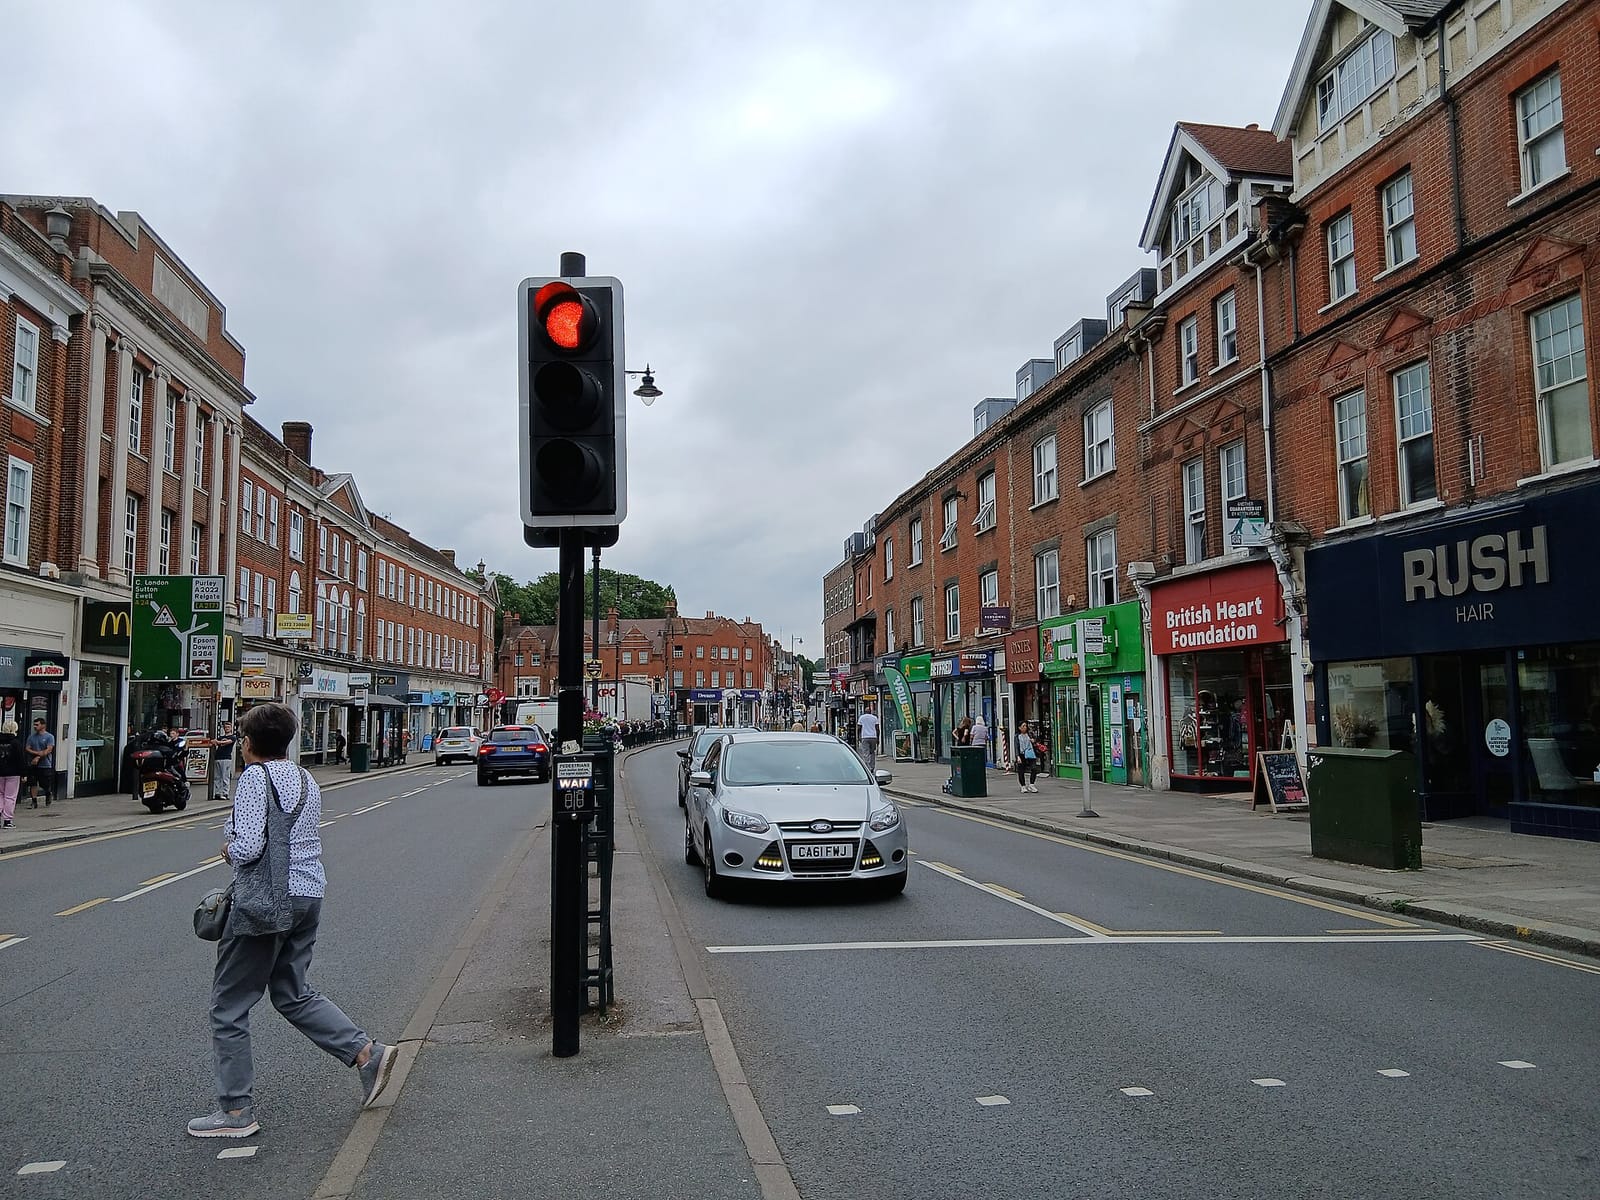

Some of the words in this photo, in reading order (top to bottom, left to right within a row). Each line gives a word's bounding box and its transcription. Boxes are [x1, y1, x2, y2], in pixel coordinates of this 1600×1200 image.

[1403, 525, 1550, 602] RUSH
[1166, 603, 1212, 629] British
[1216, 596, 1263, 620] Heart
[1456, 602, 1494, 623] HAIR
[1171, 621, 1257, 649] Foundation
[29, 667, 43, 675] PAPA
[559, 778, 590, 788] WAIT
[798, 846, 823, 857] CA61
[825, 845, 847, 857] FWJ
